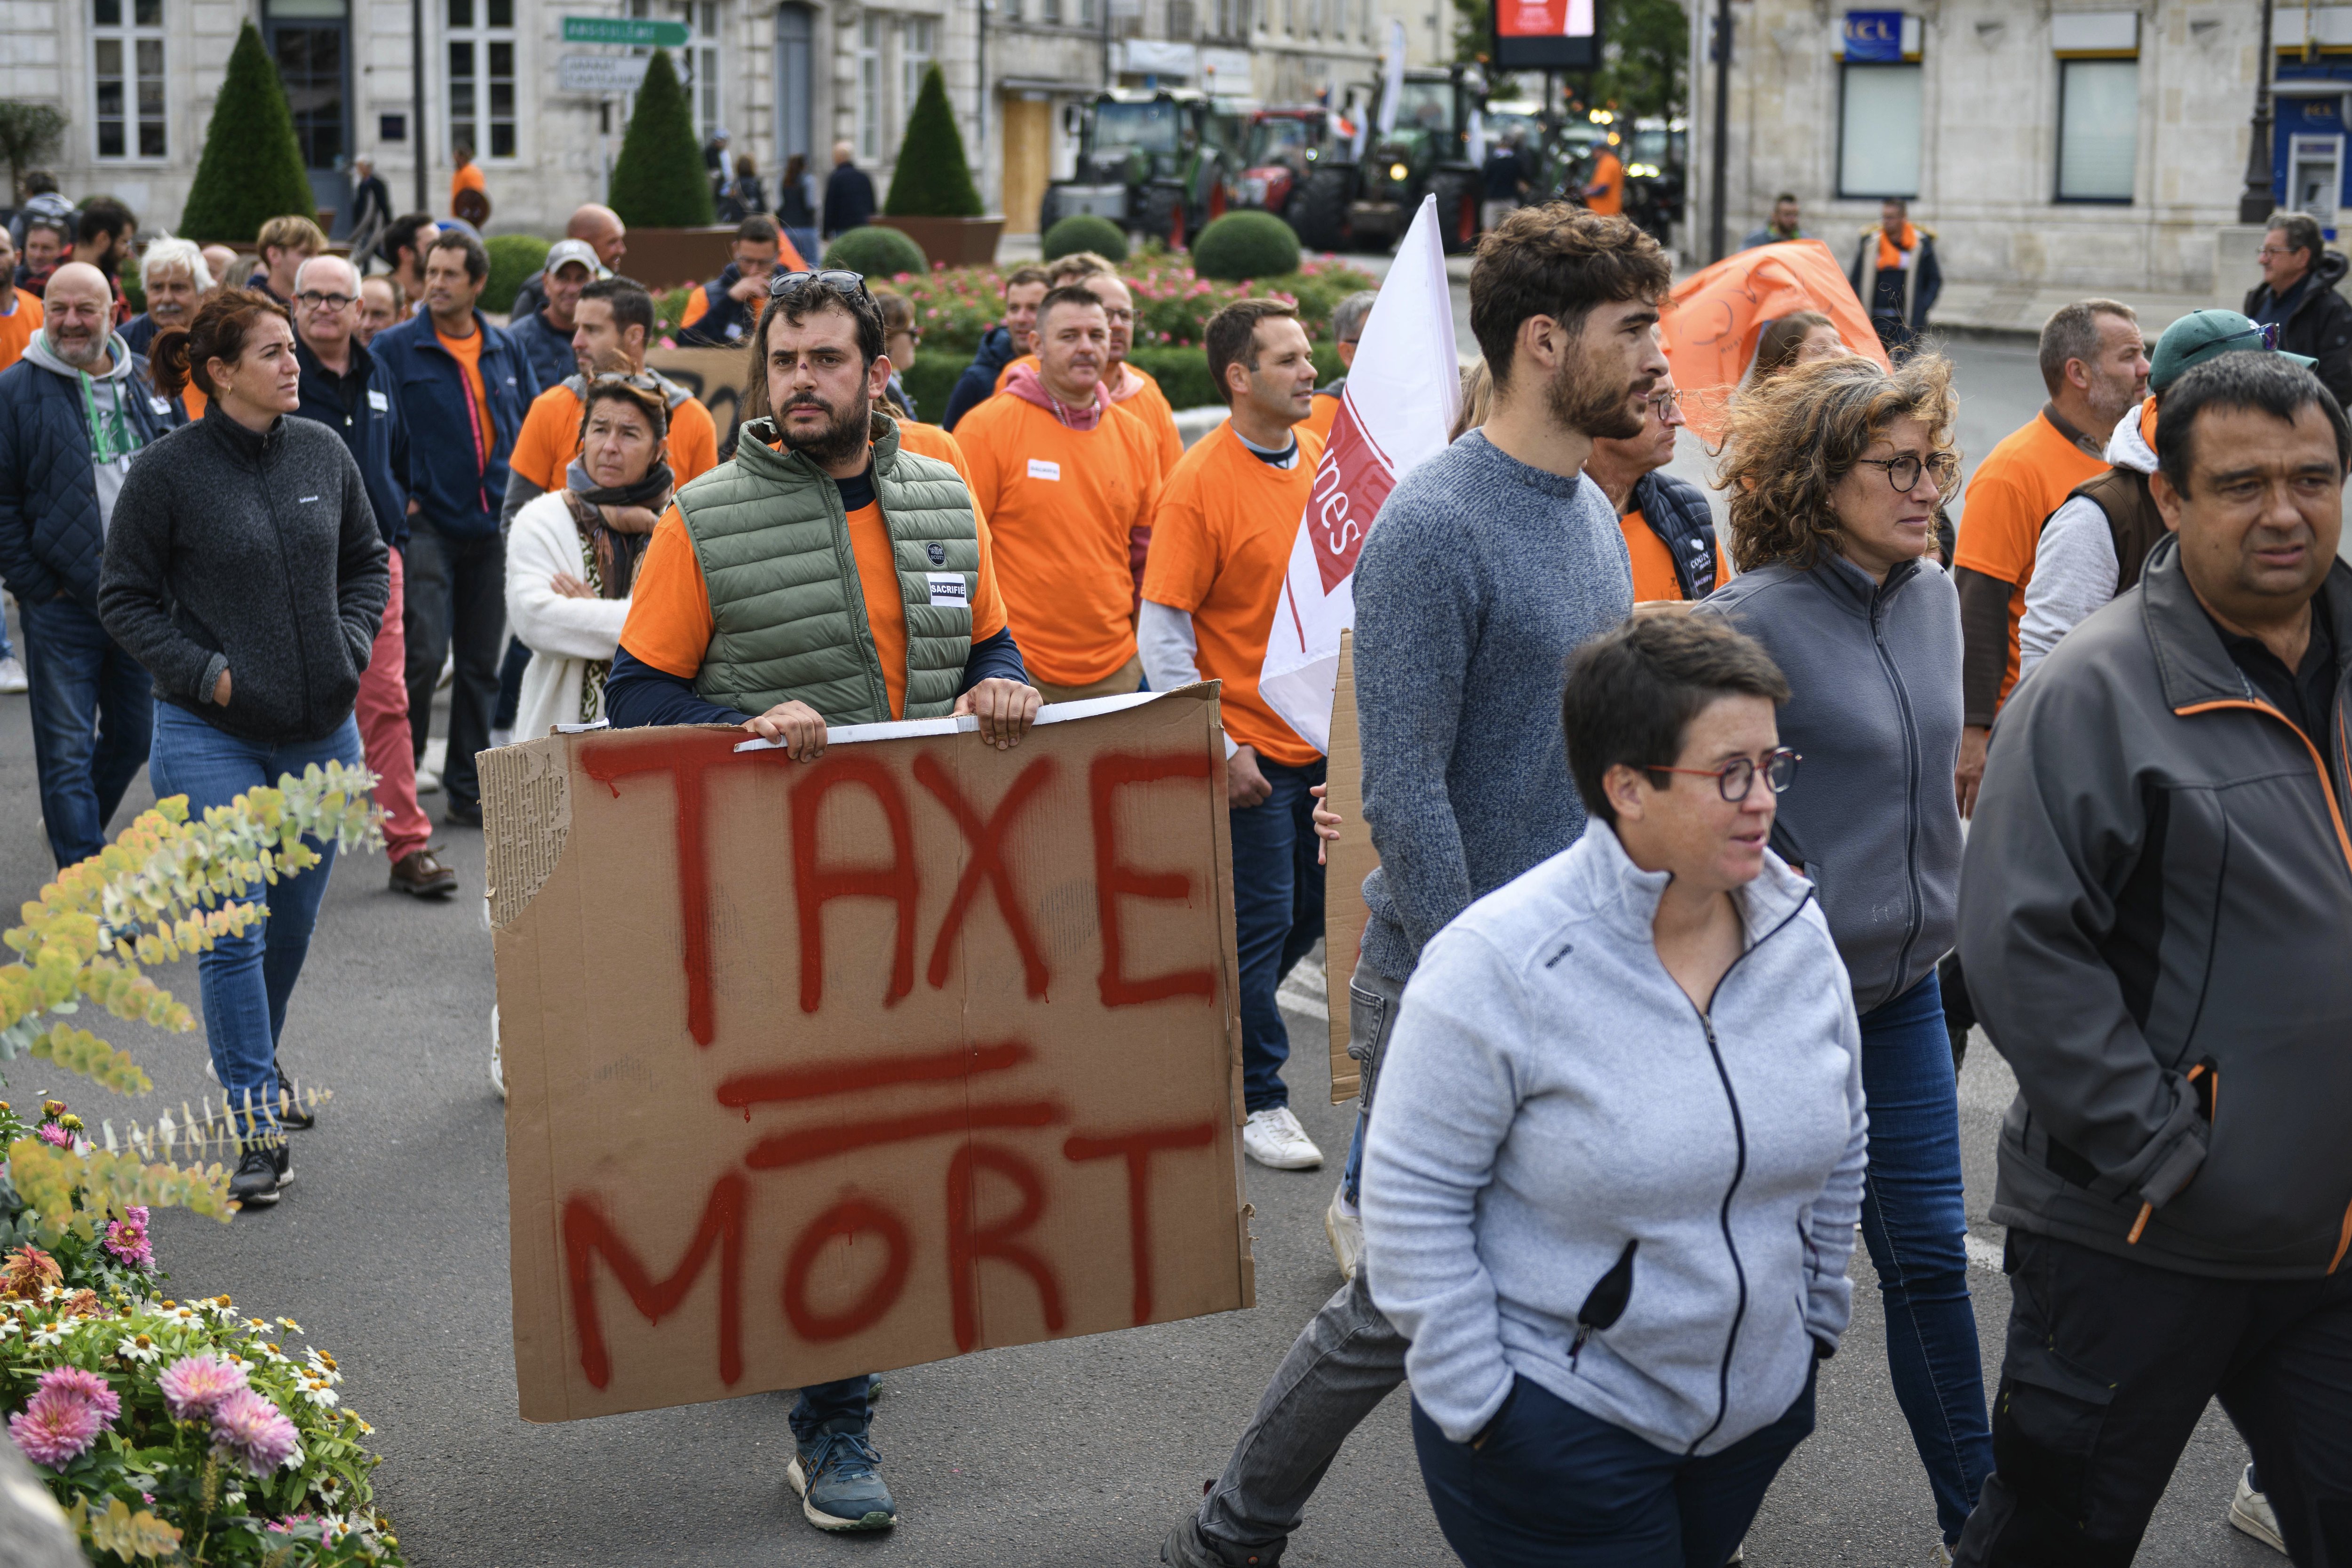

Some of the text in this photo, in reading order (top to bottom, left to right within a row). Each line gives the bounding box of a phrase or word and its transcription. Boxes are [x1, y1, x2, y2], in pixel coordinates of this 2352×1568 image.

[931, 584, 965, 595] SACRIFIÉ
[1691, 551, 1709, 569] COGN
[581, 730, 1217, 1046] TAXE
[564, 1122, 1216, 1389] MORT
